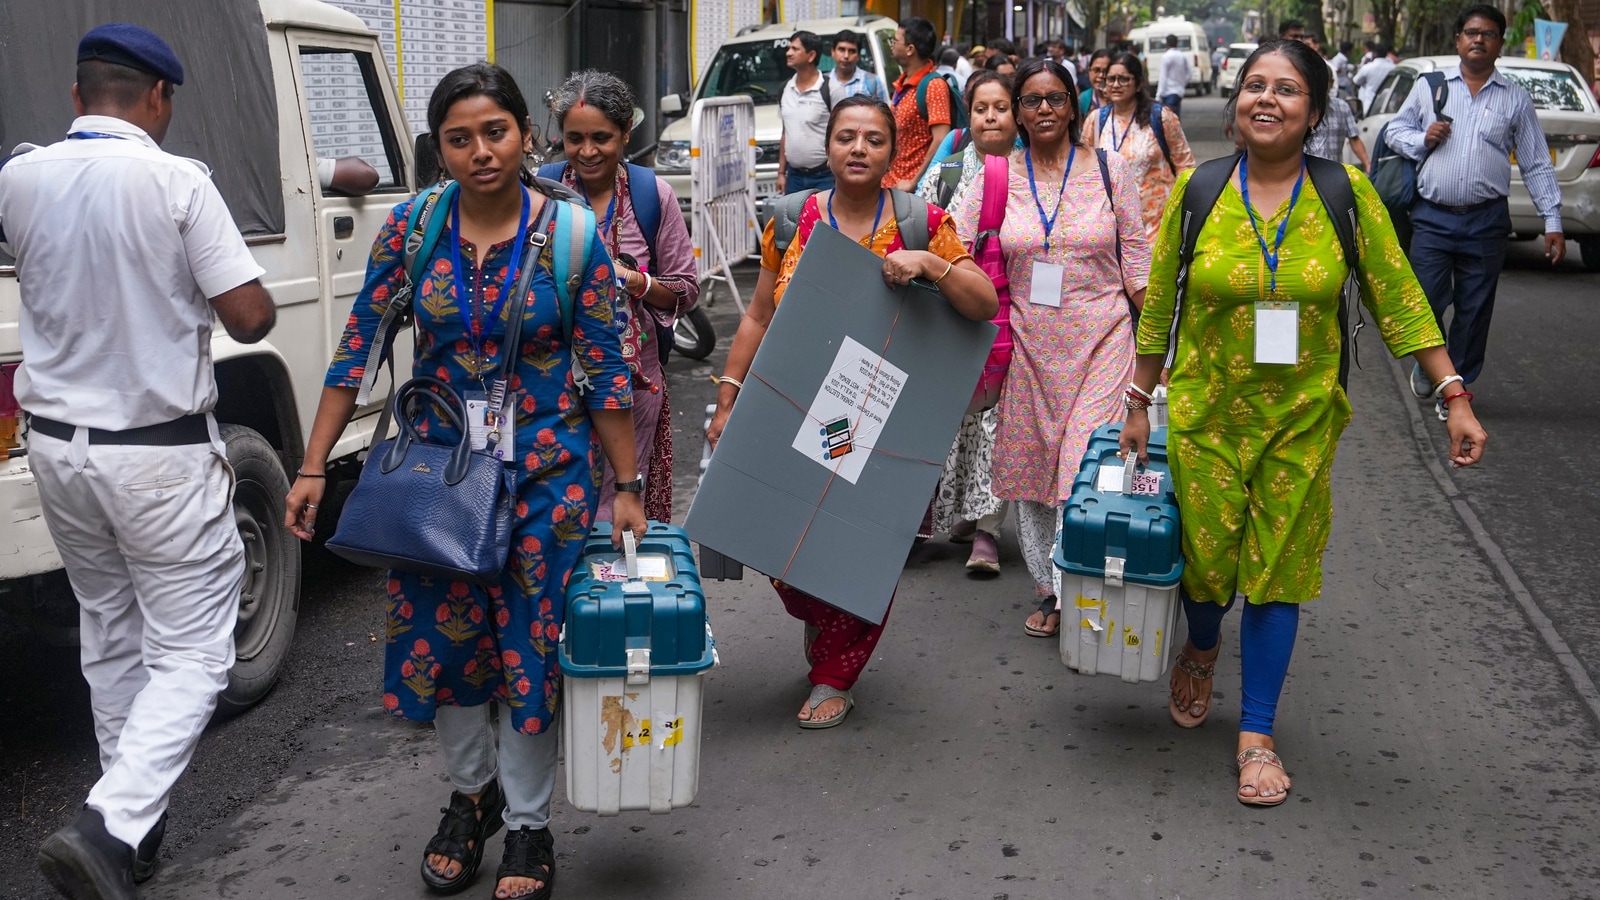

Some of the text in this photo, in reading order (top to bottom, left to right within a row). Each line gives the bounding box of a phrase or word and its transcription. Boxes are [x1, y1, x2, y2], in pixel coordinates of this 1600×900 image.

[837, 373, 851, 385] BENGAL
[824, 385, 840, 397] ELECTION
[850, 381, 860, 390] WEST
[839, 394, 854, 406] GENERAL
